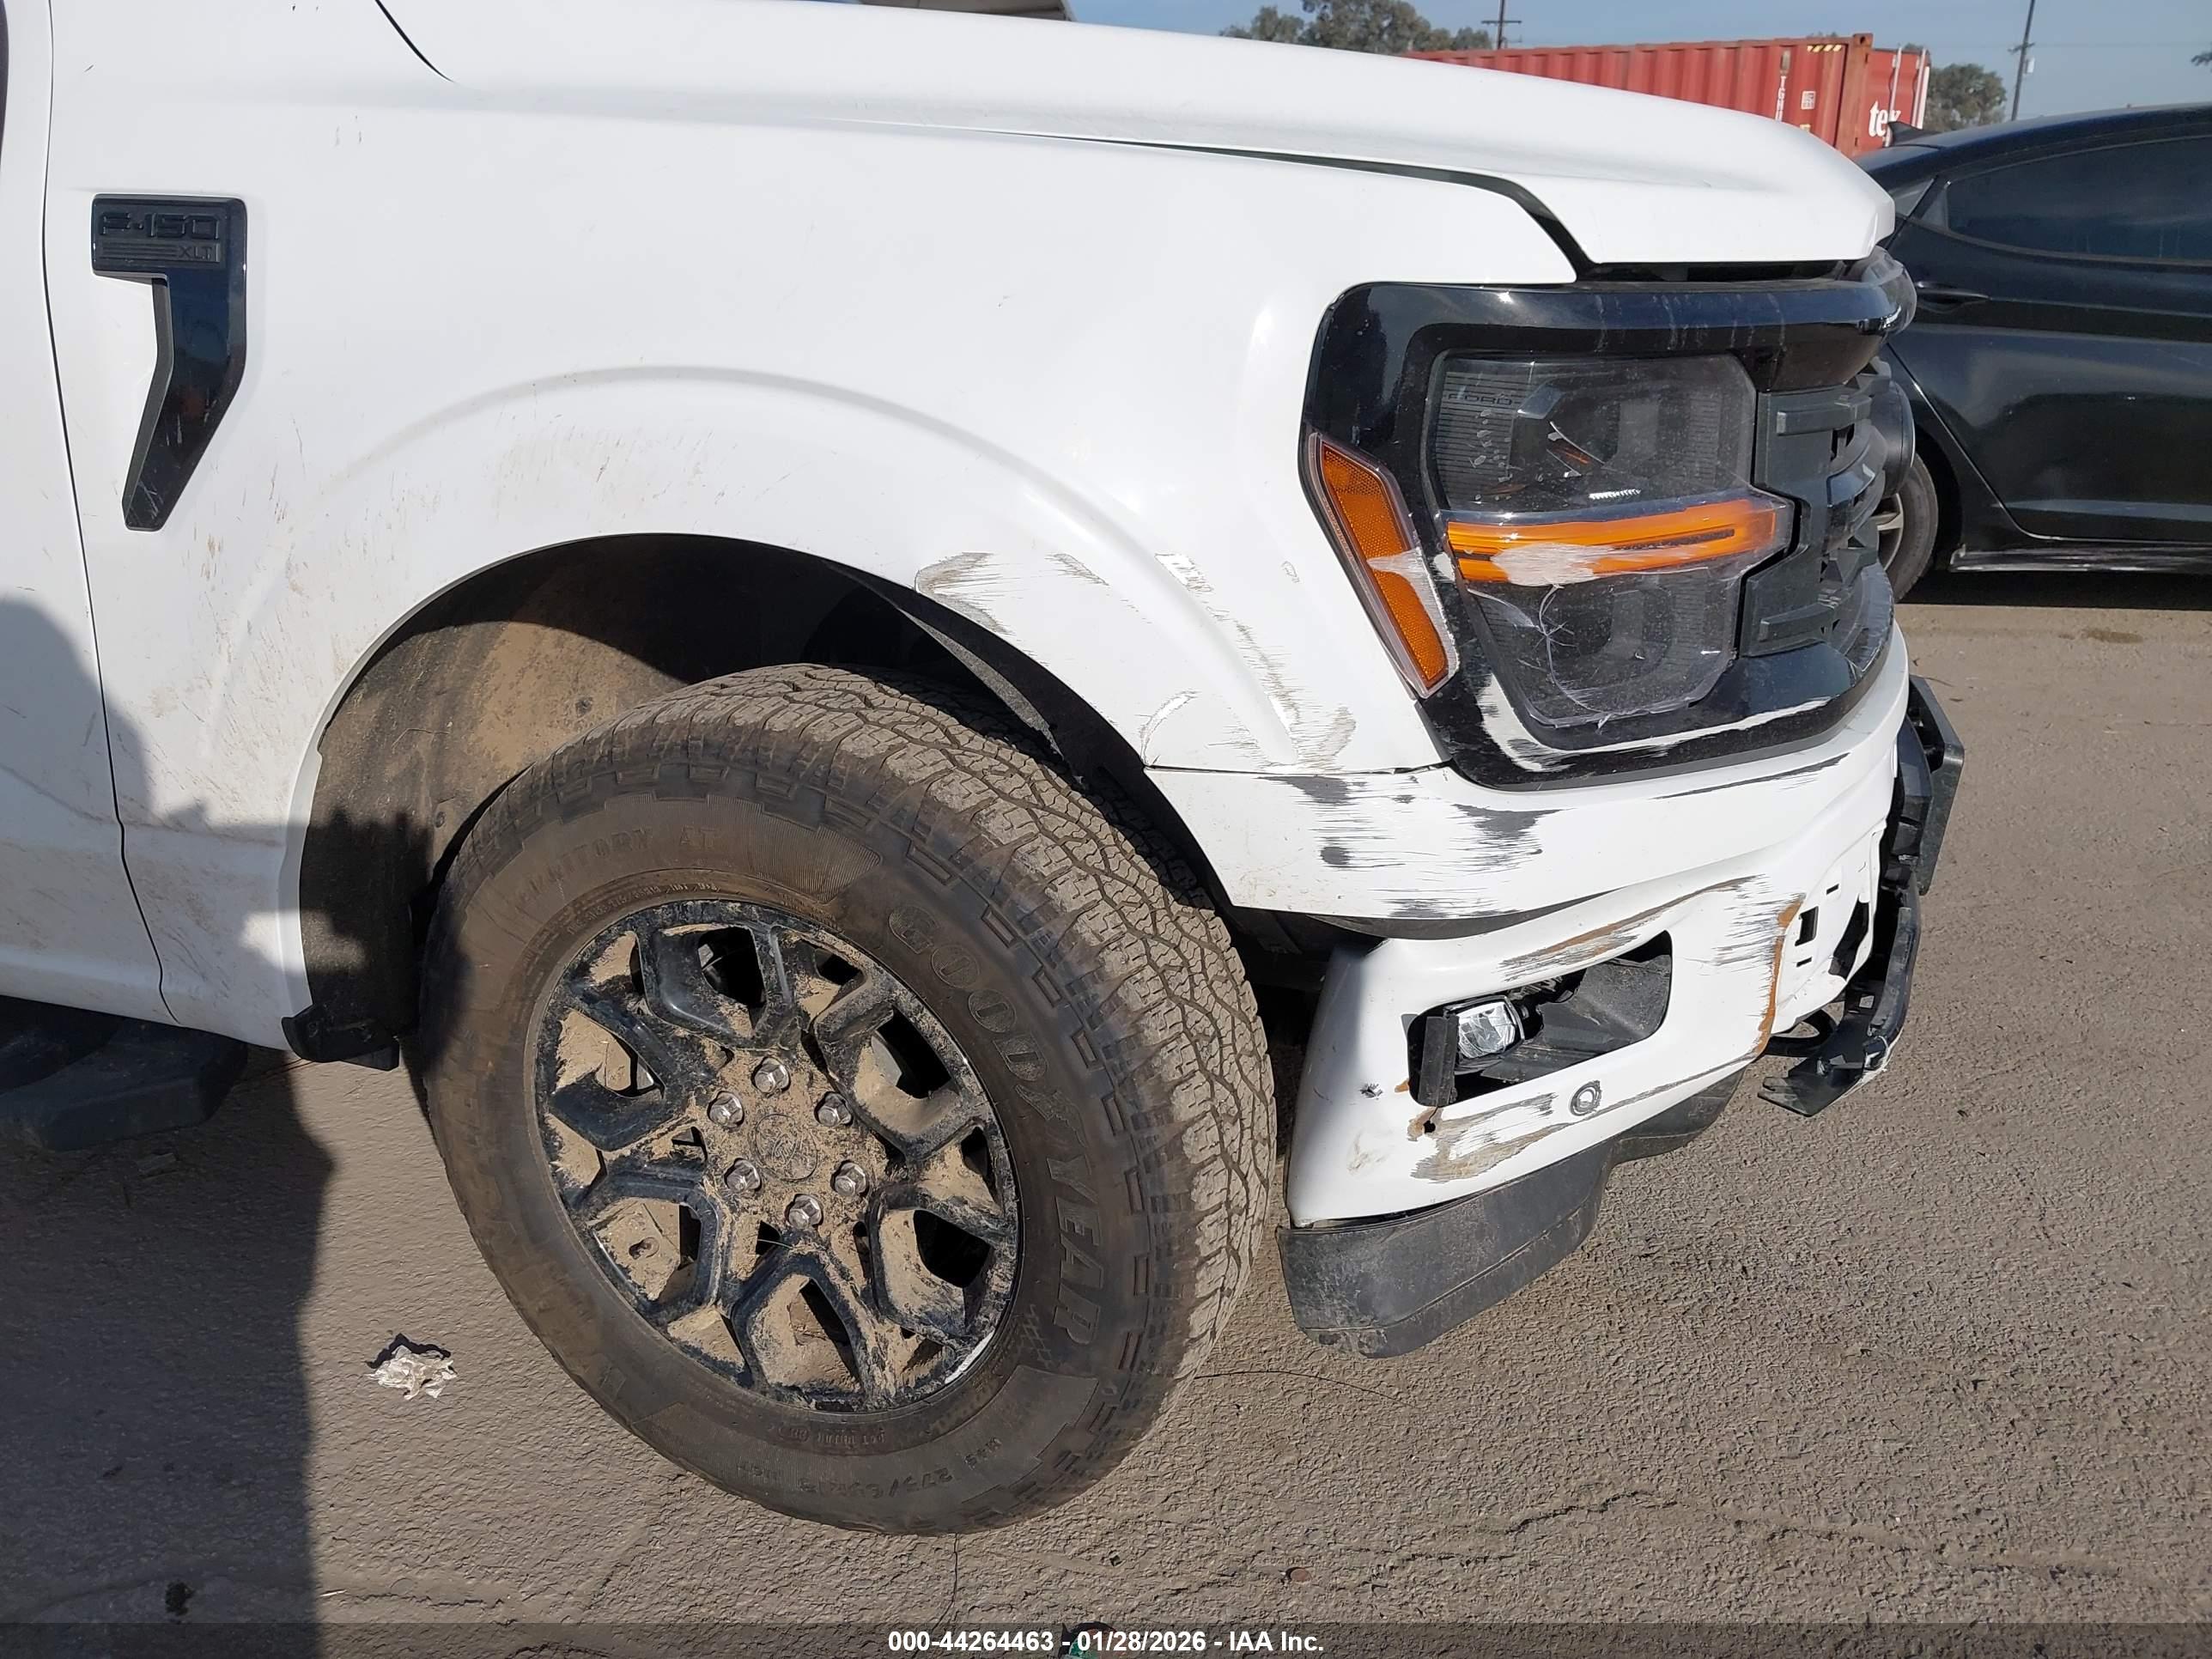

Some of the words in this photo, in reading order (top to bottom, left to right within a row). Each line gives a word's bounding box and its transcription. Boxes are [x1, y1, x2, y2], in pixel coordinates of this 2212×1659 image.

[100, 212, 220, 240] F-150
[179, 246, 214, 260] XLT
[1448, 392, 1512, 406] FORD
